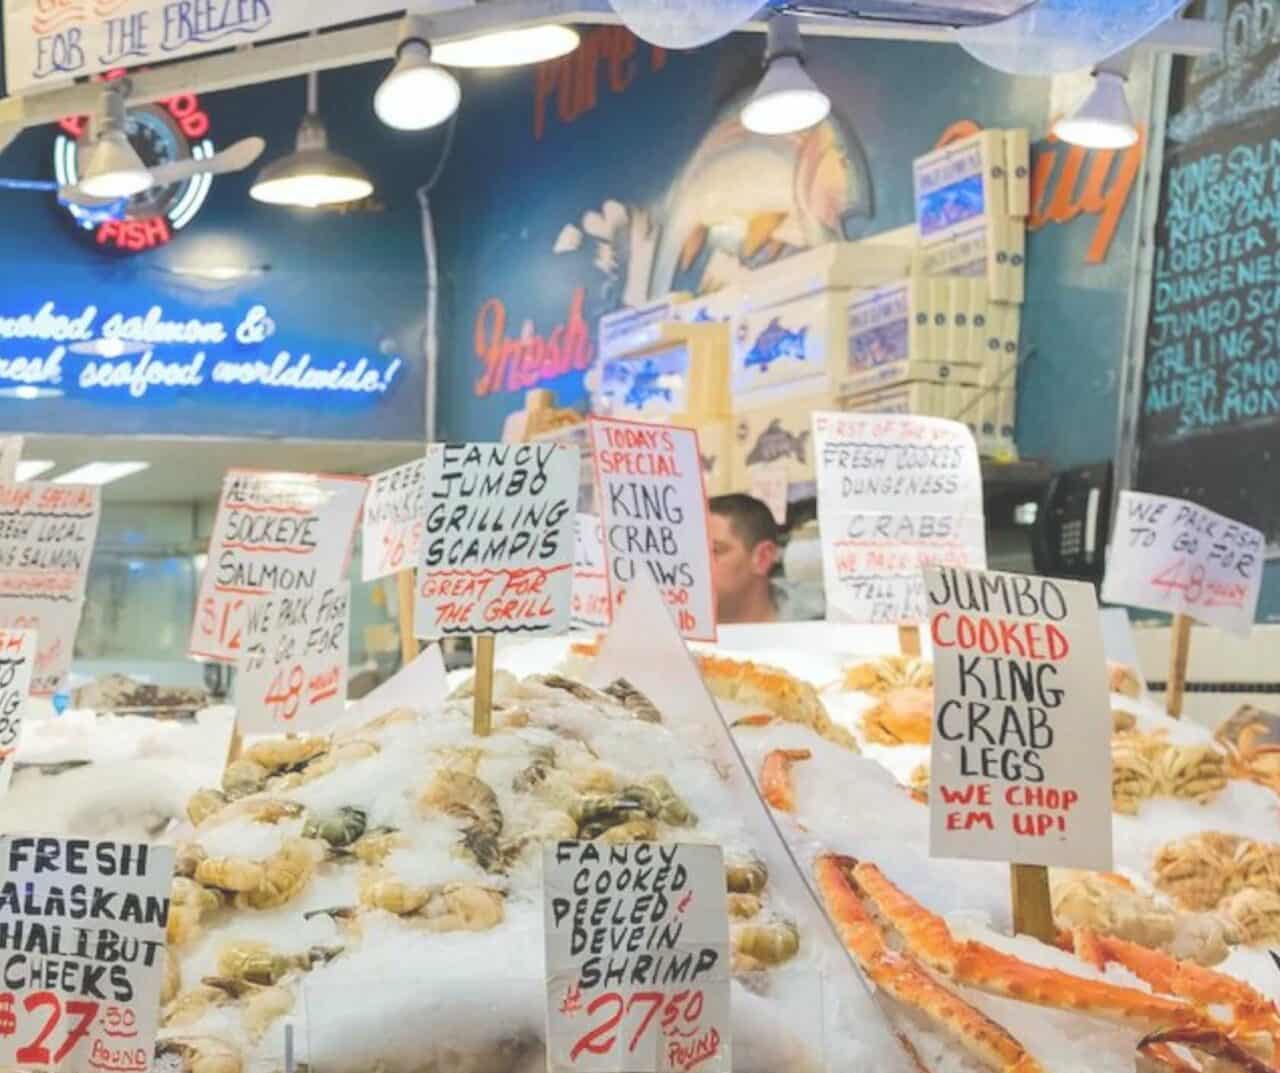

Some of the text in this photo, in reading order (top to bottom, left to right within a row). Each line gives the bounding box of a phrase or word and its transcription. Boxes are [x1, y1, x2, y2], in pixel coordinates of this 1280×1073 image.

[98, 11, 149, 63] THE
[160, 0, 272, 50] FREEZER
[96, 216, 170, 250] FISH
[102, 304, 228, 344] salmon
[79, 350, 206, 398] seafood
[440, 444, 558, 478] FANCY
[600, 451, 684, 478] SPECIAL
[823, 448, 886, 470] FRESH
[431, 470, 549, 498] JUMBO
[840, 474, 959, 498] DUNGENESS
[426, 499, 569, 534] GRILLING
[609, 482, 684, 525] KING
[226, 513, 319, 546] SOCKEYE
[608, 524, 678, 556] CRAB
[426, 530, 560, 567] SCAMPIS
[218, 551, 317, 590] SALMON
[422, 578, 491, 598] GREAT
[435, 594, 555, 625] THE GRILL
[929, 564, 1069, 621] JUMBO
[931, 611, 1070, 661] COOKED
[958, 653, 1065, 709] KING
[937, 699, 1054, 750] CRAB
[960, 746, 1046, 783] LEGS
[939, 784, 1079, 811] WE CHOP
[946, 811, 1067, 841] EM UP!
[8, 838, 148, 877] FRESH
[556, 841, 679, 870] FANCY
[573, 864, 688, 896] COOKED
[552, 892, 669, 929] PEELED
[571, 920, 683, 956] DEVEIN
[4, 953, 134, 1002] CHEEKS
[577, 948, 719, 989] SHRIMP
